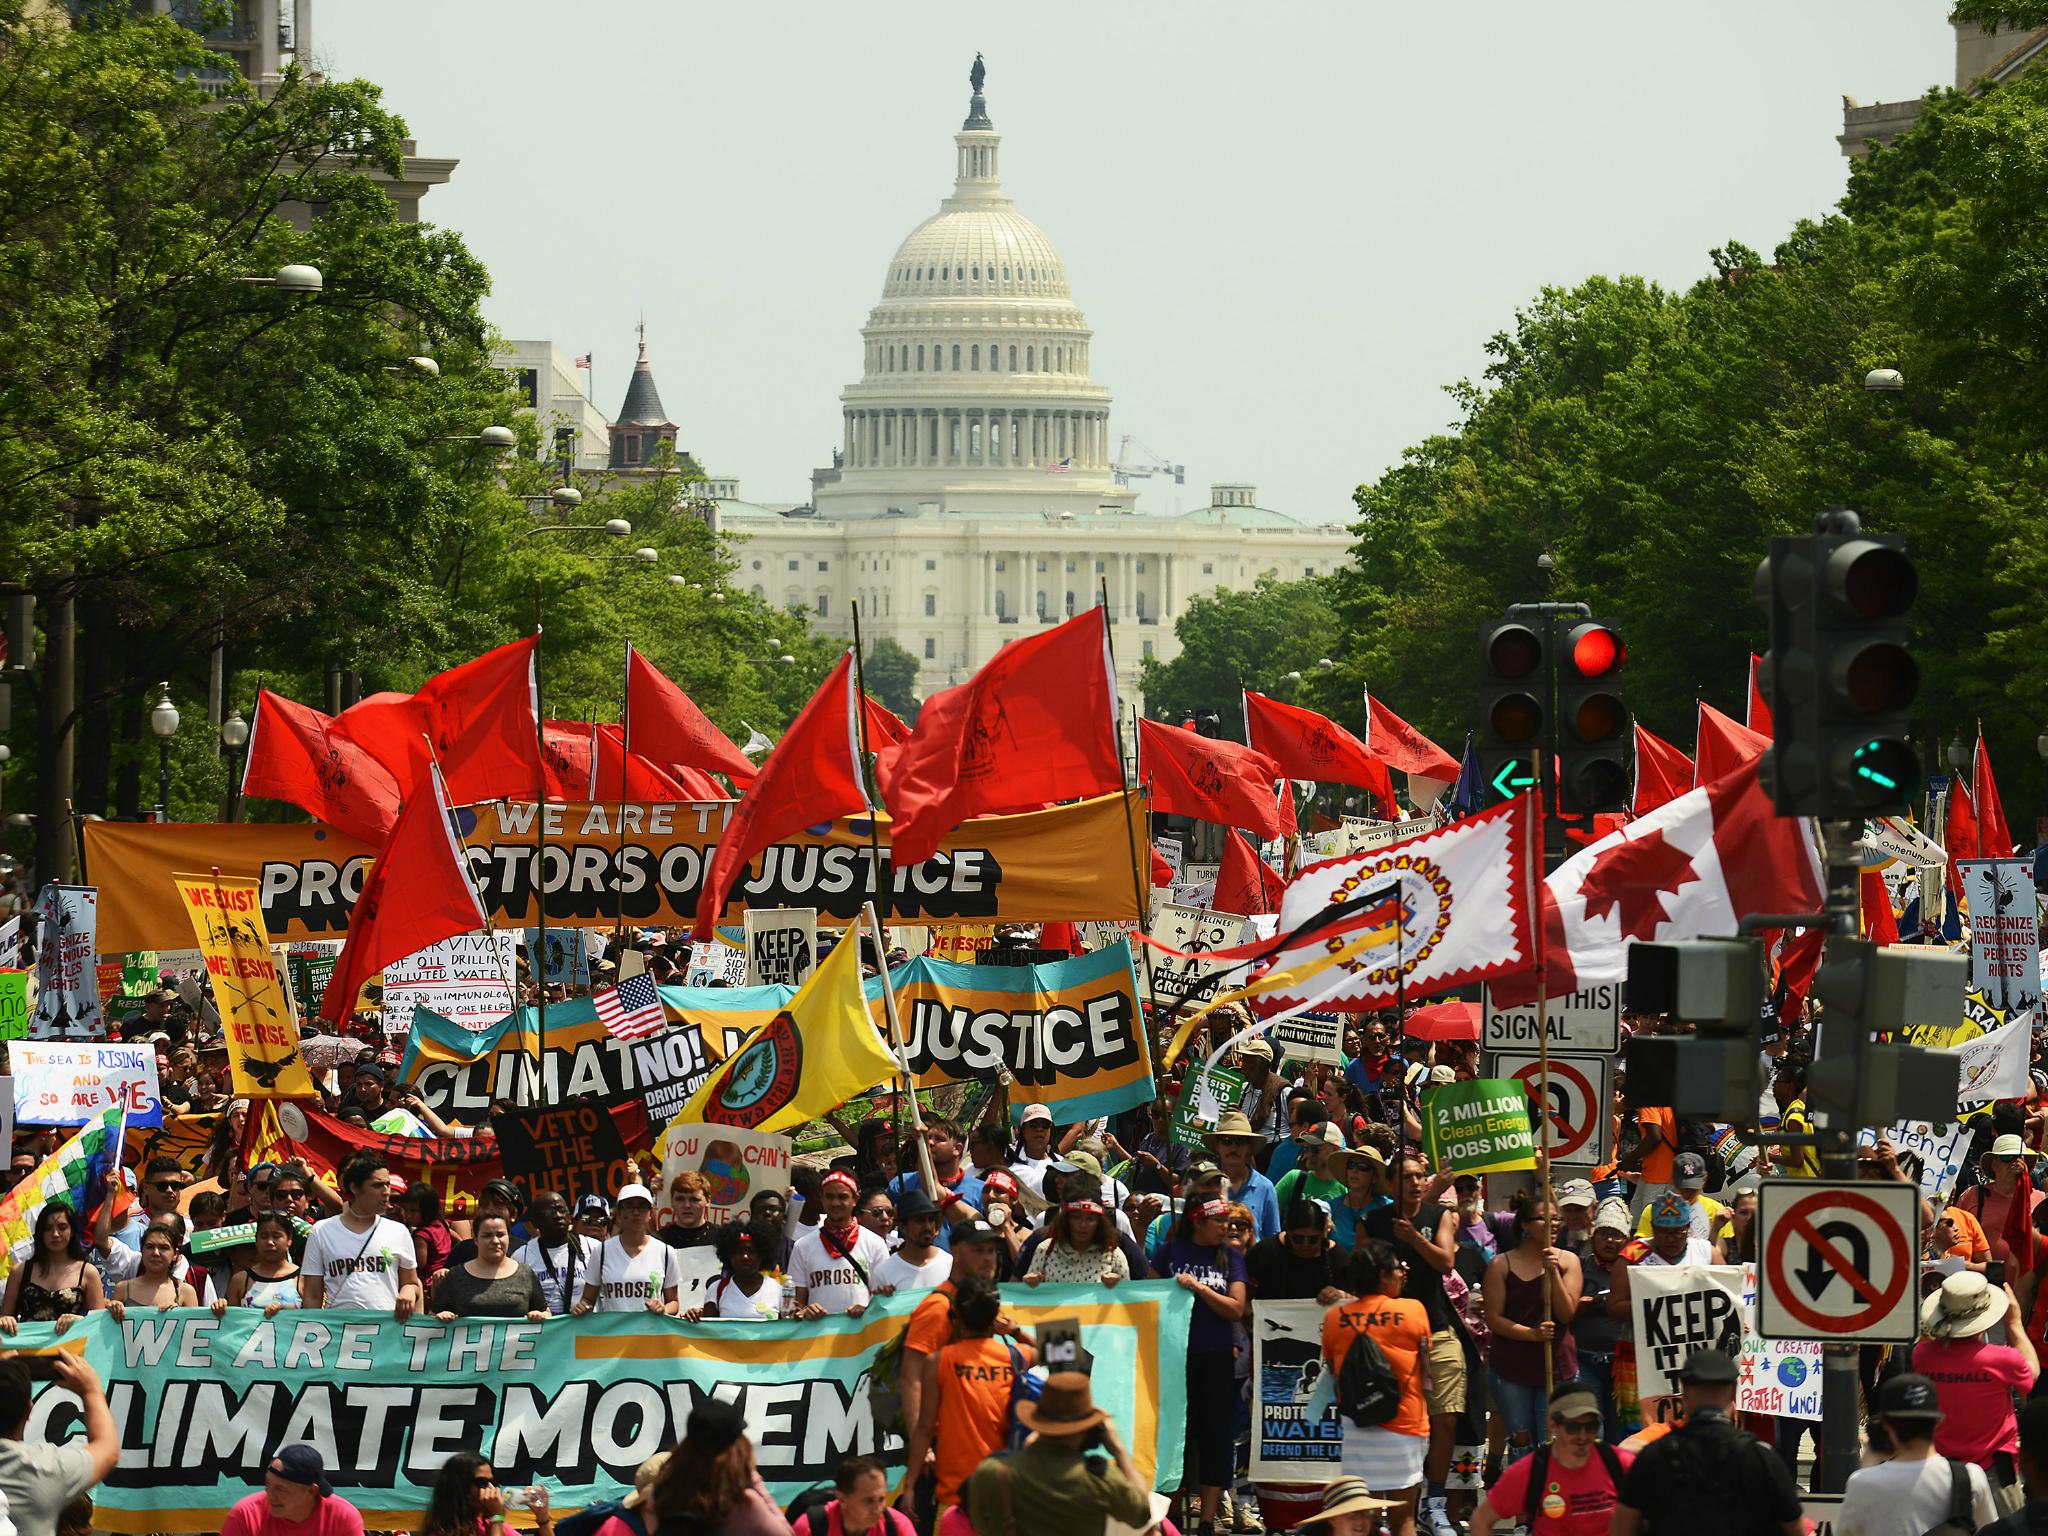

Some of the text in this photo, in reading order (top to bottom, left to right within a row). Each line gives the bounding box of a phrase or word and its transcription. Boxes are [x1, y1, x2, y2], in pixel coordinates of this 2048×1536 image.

[497, 803, 567, 834] WE
[580, 803, 676, 835] ARE
[1368, 825, 1427, 841] NO PIPELINES!
[744, 846, 984, 893] JUSTICE
[185, 888, 255, 912] WE EXIST
[1174, 911, 1235, 928] NO PIPELINES!
[754, 928, 804, 961] KEEP
[204, 955, 232, 977] WE
[311, 967, 333, 975] RESIST
[418, 955, 444, 967] OIL
[451, 954, 510, 967] DRILLING
[757, 958, 790, 974] IT IN
[384, 970, 447, 984] POLLUTED
[722, 976, 745, 987] YOU
[723, 967, 744, 978] ARE
[761, 973, 790, 986] THE
[386, 991, 403, 1001] GOT
[456, 1004, 478, 1012] ONE
[231, 1023, 290, 1047] WE RISE
[894, 997, 1125, 1070] JUSTICE
[1490, 1014, 1573, 1041] SIGNAL
[22, 1049, 145, 1071] THE SEA IS RISING
[634, 1028, 706, 1087] NO!
[72, 1073, 101, 1087] AND
[415, 1036, 652, 1109] CLIMAT
[40, 1092, 99, 1107] SO ARE
[645, 1081, 687, 1106] DRIVE
[1439, 1095, 1525, 1124] 2 MILLION
[520, 1106, 600, 1141] VETO
[1440, 1115, 1529, 1141] Clean Energy
[534, 1136, 595, 1168] THE
[666, 1138, 699, 1159] YOU
[1445, 1132, 1533, 1161] JOBS NOW
[328, 1255, 385, 1278] UPROSE
[1339, 1312, 1406, 1328] STAFF
[1643, 1288, 1732, 1348] KEEP
[122, 1319, 544, 1373] WE ARE THE
[1743, 1340, 1767, 1353] OUR
[1653, 1346, 1677, 1371] IT
[1741, 1387, 1784, 1411] PROTECT
[22, 1383, 479, 1472] CLIMATE
[1262, 1444, 1302, 1456] DEFEND
[1305, 1444, 1326, 1457] THE
